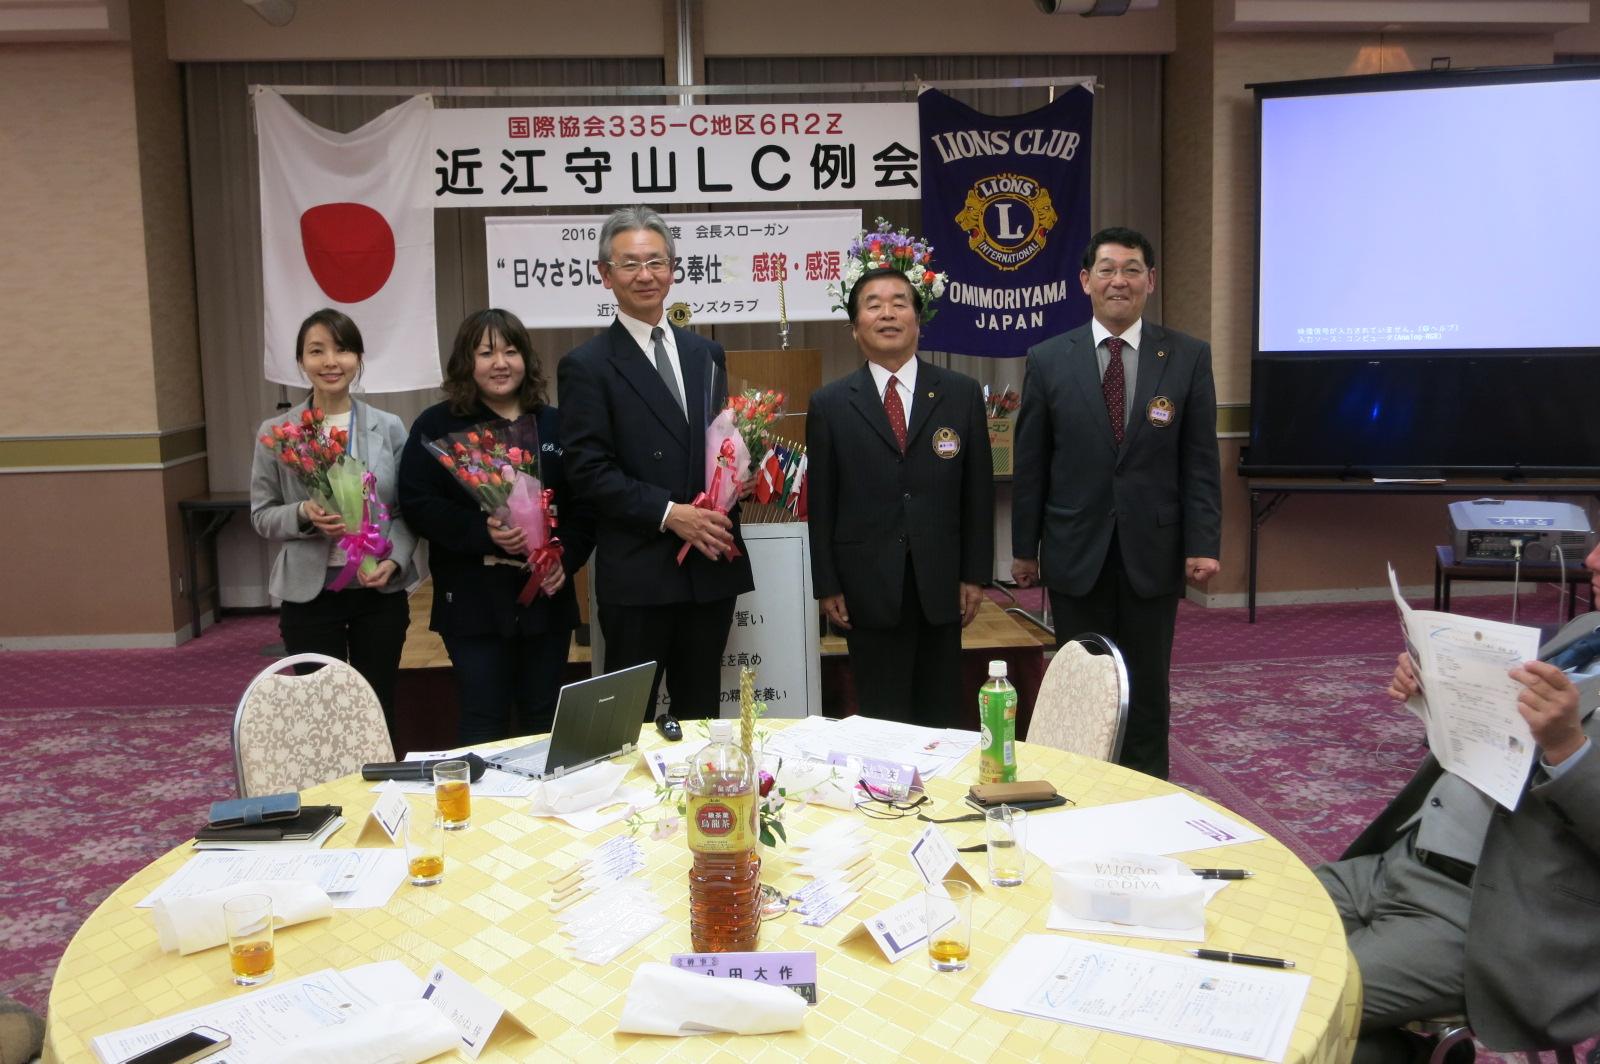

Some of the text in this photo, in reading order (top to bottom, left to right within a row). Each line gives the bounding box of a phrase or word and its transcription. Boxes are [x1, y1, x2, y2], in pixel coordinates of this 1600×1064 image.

[931, 129, 1081, 164] LIONS CLUB
[435, 141, 919, 196] 近江守山LC例会
[980, 178, 1034, 198] LIONS
[562, 228, 596, 241] 2016
[695, 223, 789, 239] 会長スローガン
[994, 203, 1025, 239] L
[978, 241, 1039, 264] INTERNATIONAL
[949, 279, 1067, 309] OMIMORIYAMA
[975, 310, 1043, 331] JAPAN
